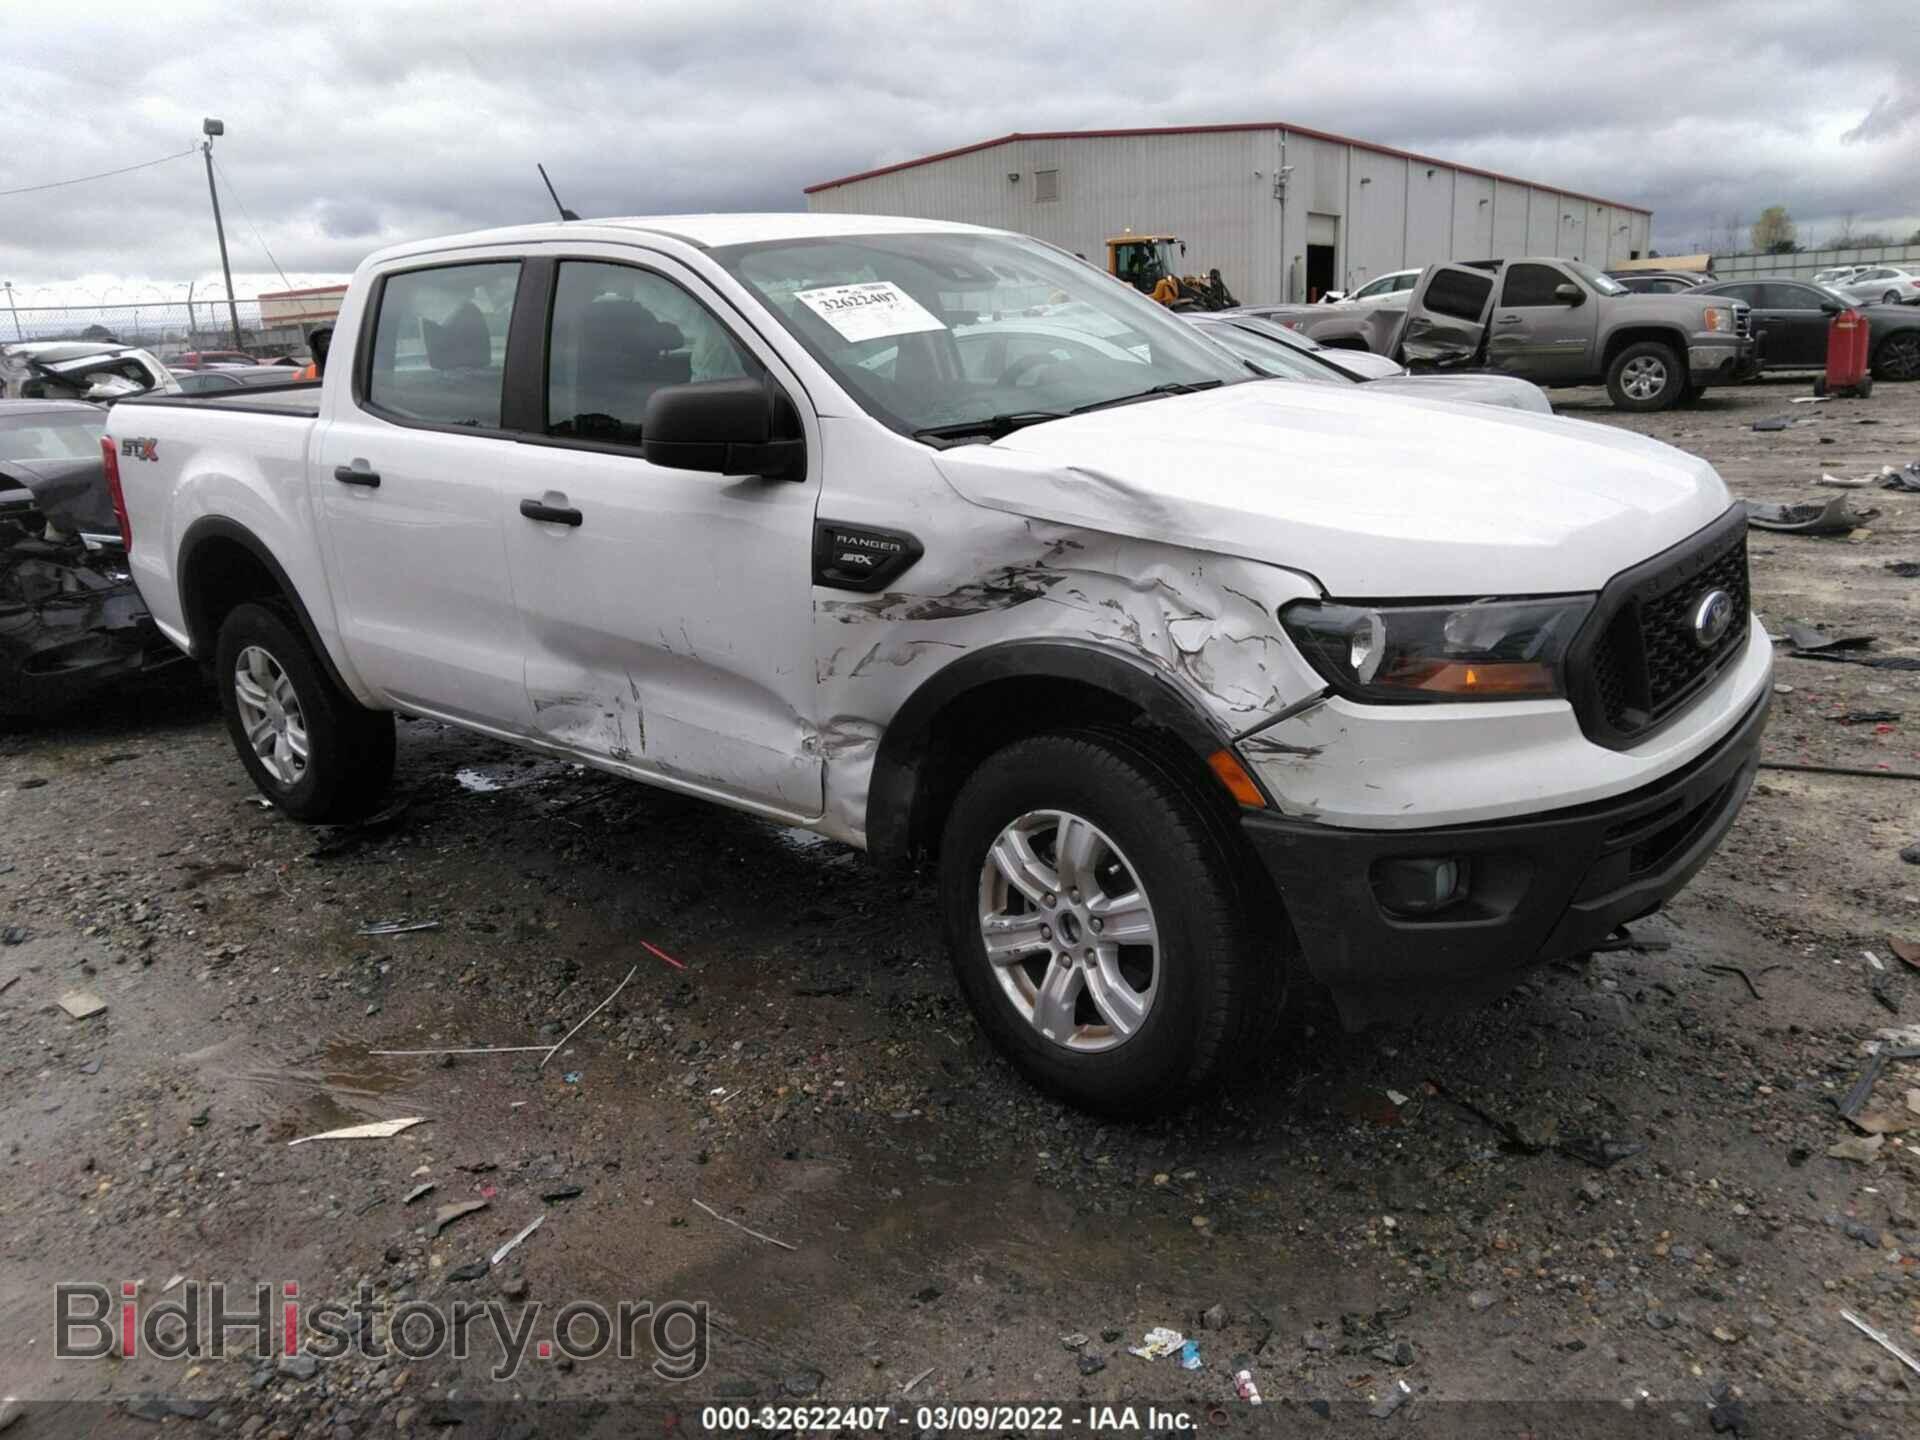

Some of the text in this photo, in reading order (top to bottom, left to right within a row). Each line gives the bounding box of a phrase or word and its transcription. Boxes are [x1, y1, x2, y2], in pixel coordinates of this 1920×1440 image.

[819, 292, 898, 310] 32622407
[121, 437, 159, 461] STX
[837, 535, 900, 551] RANGER
[840, 553, 873, 565] STX
